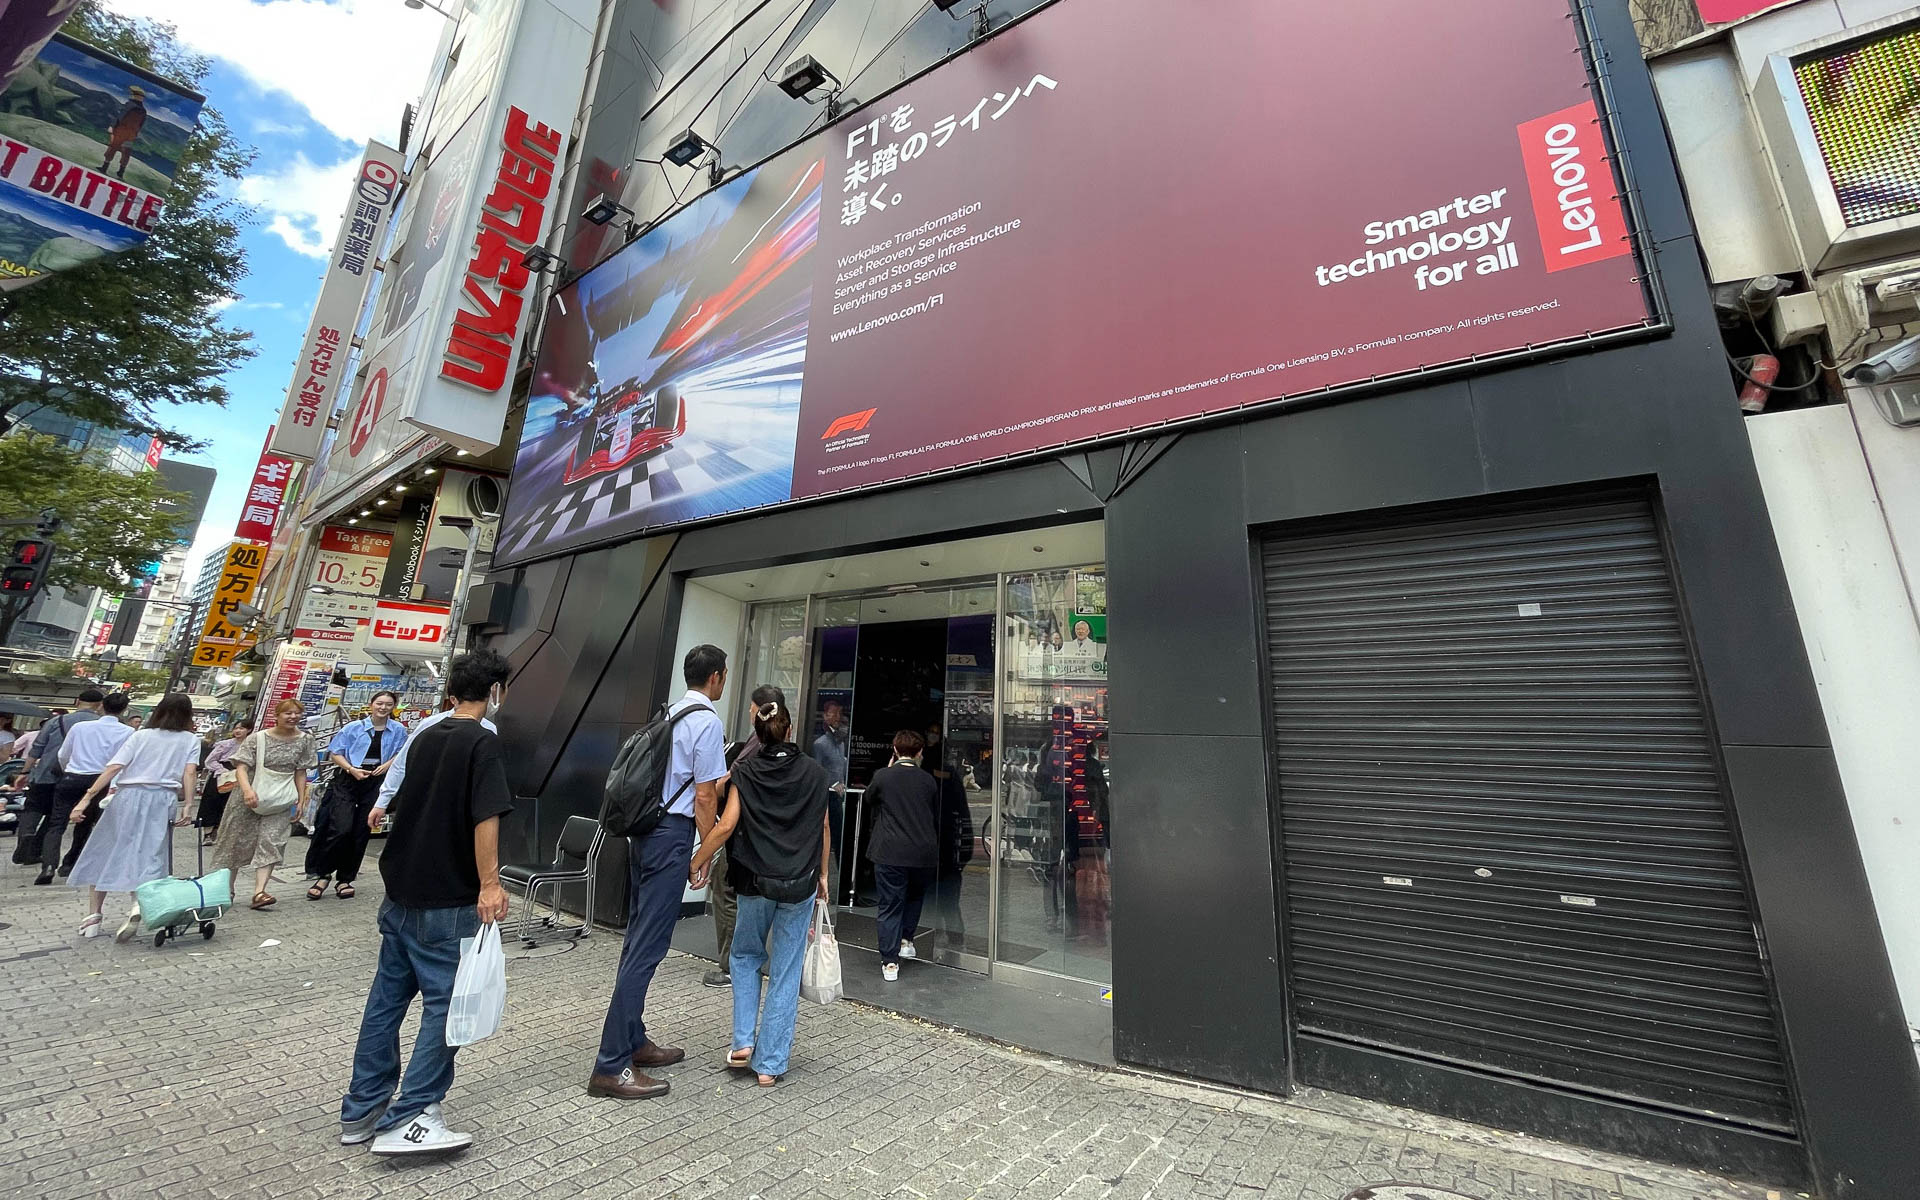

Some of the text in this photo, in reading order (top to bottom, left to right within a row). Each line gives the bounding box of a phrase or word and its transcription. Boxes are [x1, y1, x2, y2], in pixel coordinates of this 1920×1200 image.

[842, 73, 1058, 193] 未踏のラインへ
[0, 137, 164, 232] T BATTLE
[840, 182, 902, 226] 導く。
[1544, 122, 1602, 255] Lenovo
[338, 200, 382, 276] 調剤薬局
[837, 201, 982, 268] Workplace Transformation
[1364, 186, 1507, 245] Smarter
[834, 217, 1022, 299] Server and Storage Infrastructure
[835, 223, 967, 284] Asset Recovery Services
[1314, 216, 1512, 287] technology
[1413, 241, 1519, 291] for all
[832, 260, 957, 315] Everything as a Service
[830, 292, 944, 343] www.Lenovo.com/F1
[293, 325, 341, 427] 処方せん受付
[832, 462, 856, 472] FORMULA
[936, 438, 964, 449] FORMULA
[964, 434, 979, 442] ONE
[979, 428, 1004, 439] WORLD
[1080, 405, 1097, 415] PRIX
[1097, 402, 1112, 412] and
[1112, 396, 1137, 410] related
[1138, 391, 1160, 402] marks
[1161, 388, 1174, 397] are
[1174, 377, 1219, 394] trademarks
[1220, 373, 1230, 383] of
[1230, 366, 1266, 381] Formula
[1266, 361, 1286, 372] One
[1286, 352, 1329, 368] Licensing
[1348, 346, 1355, 354] a
[1356, 336, 1397, 352] Formula
[1404, 324, 1455, 342] company.
[1456, 320, 1471, 330] All
[1472, 312, 1506, 326] rights
[1507, 298, 1561, 318] reserved.
[335, 531, 391, 547] Tax Free
[402, 544, 420, 584] Vivobook
[317, 560, 344, 584] 10
[359, 566, 378, 588] 5
[198, 646, 231, 662] 3F
[286, 647, 338, 660] Floor Guide
[373, 619, 446, 643] ビック
